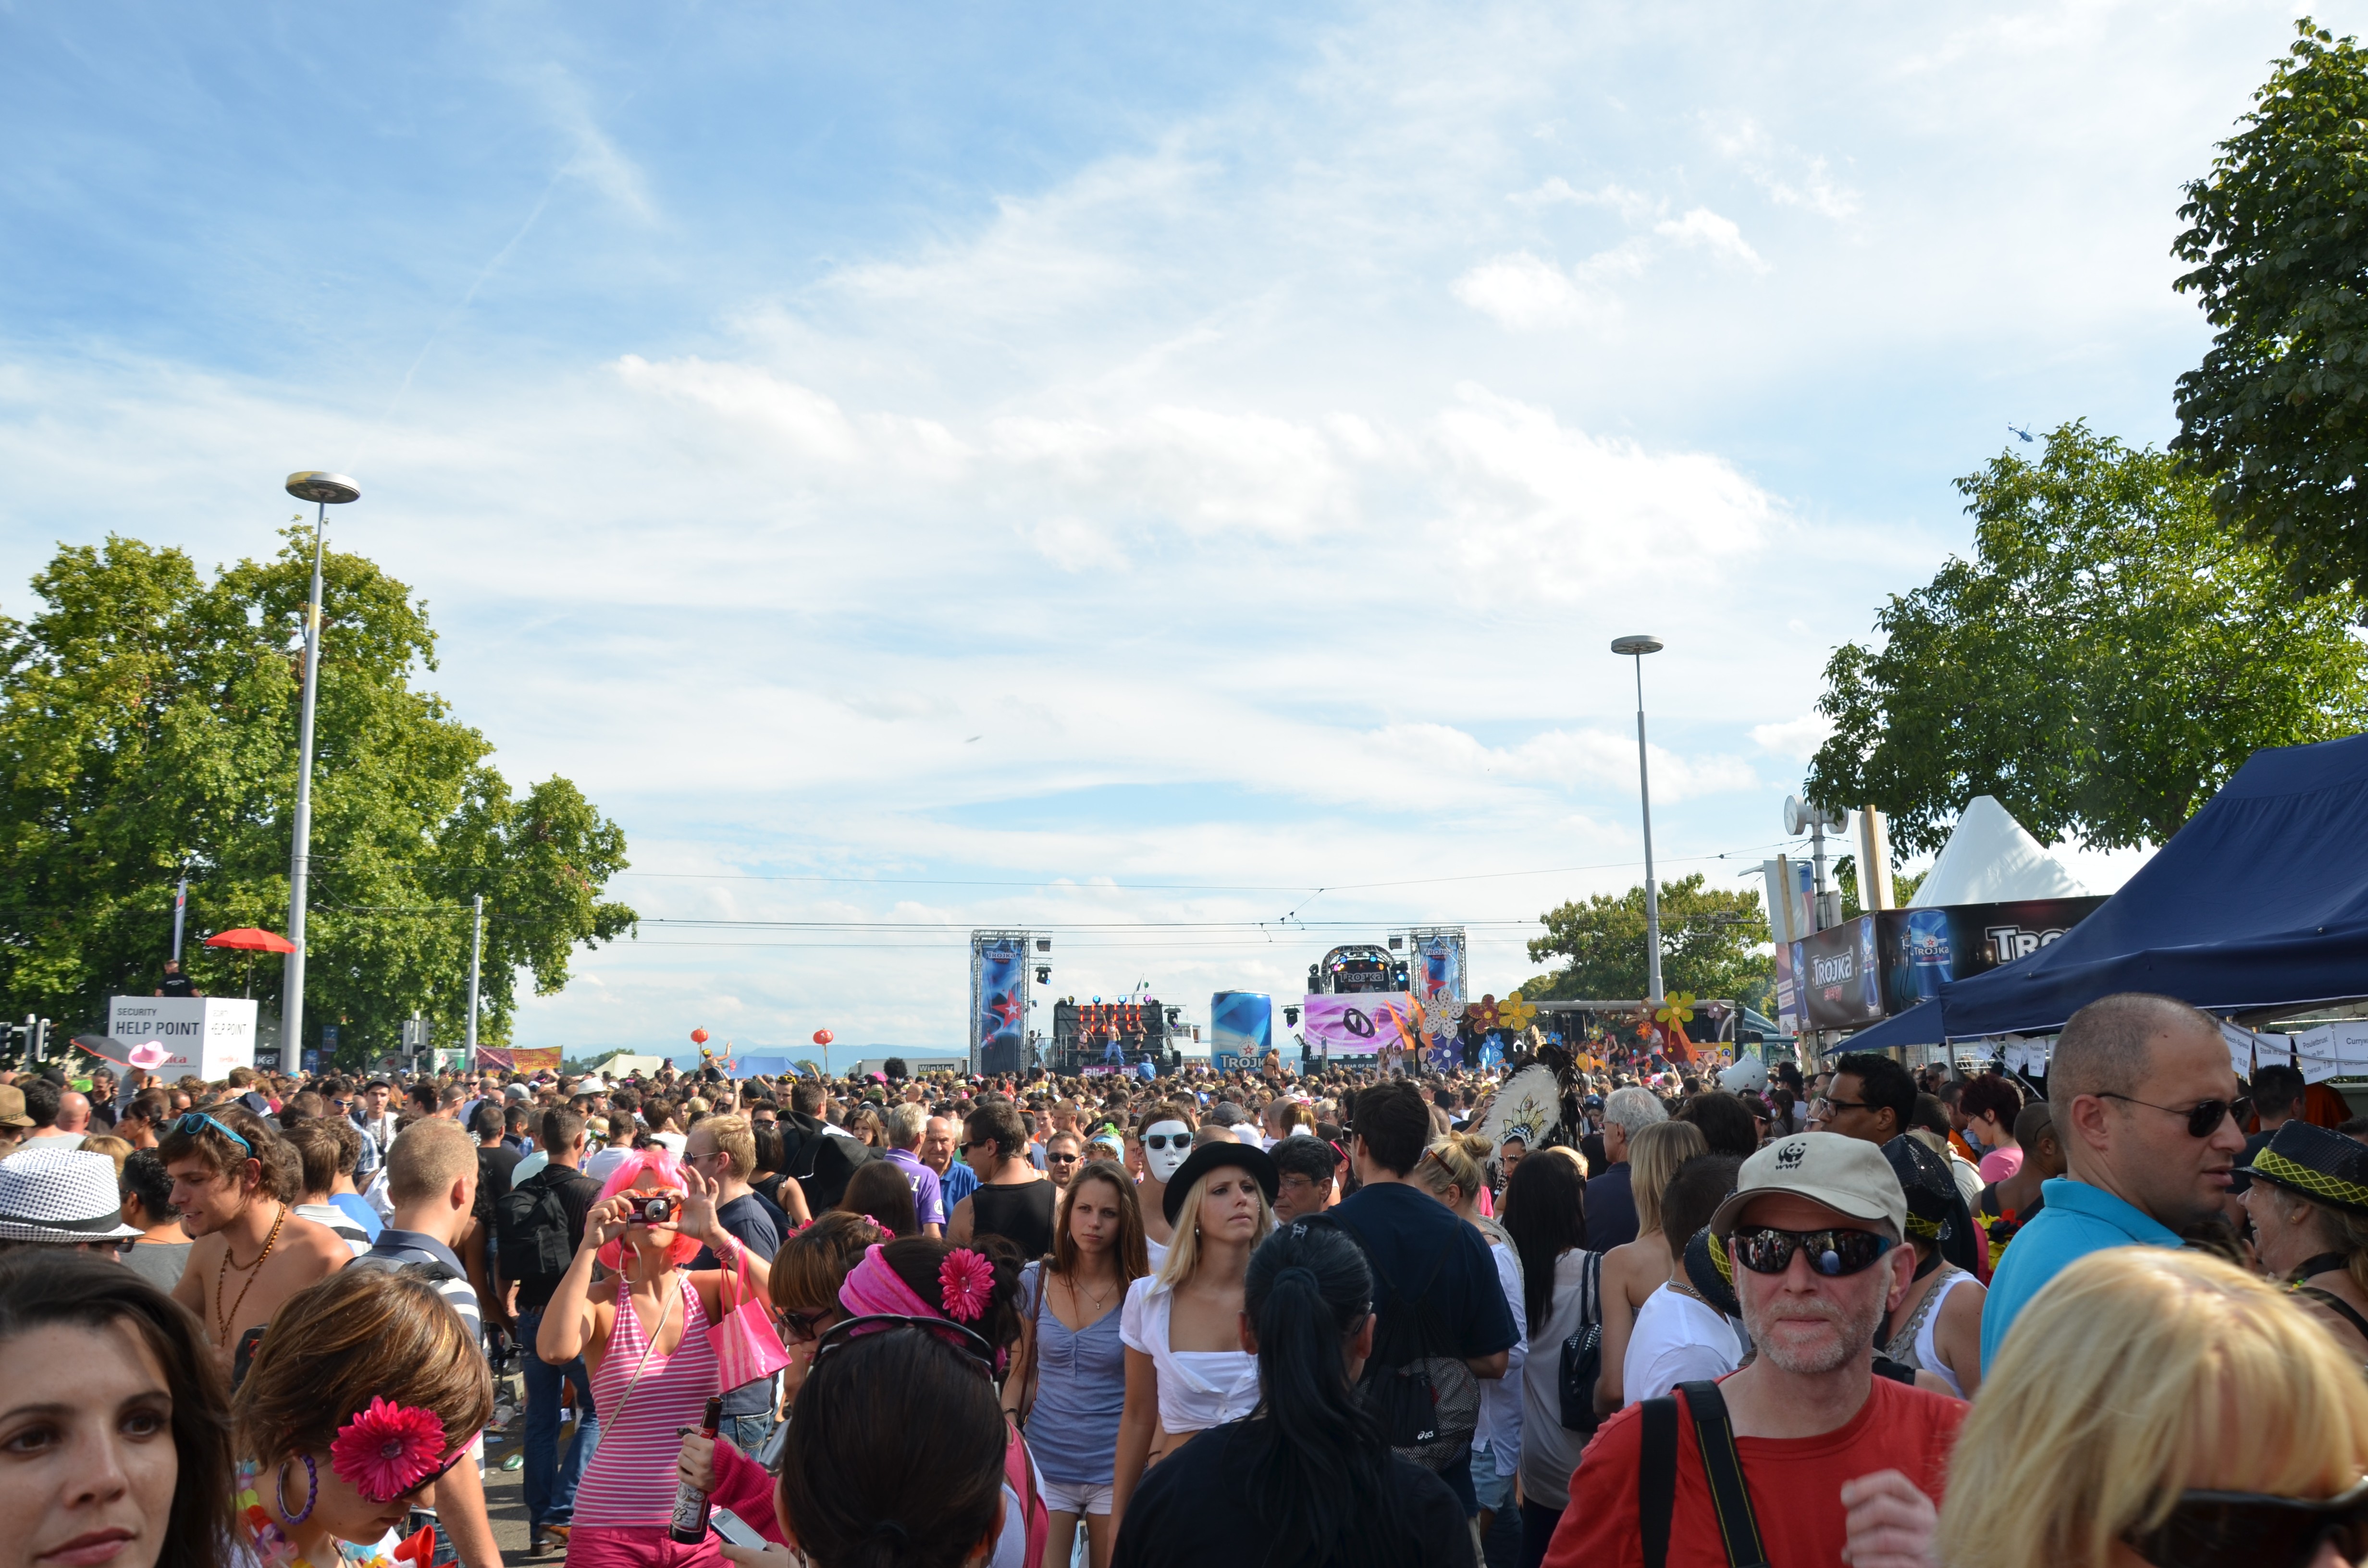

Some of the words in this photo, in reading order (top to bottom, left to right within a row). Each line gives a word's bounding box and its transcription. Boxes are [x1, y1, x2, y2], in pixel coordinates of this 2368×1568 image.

[117, 1008, 157, 1016] SECURITY
[116, 1021, 151, 1034] HELP
[156, 1022, 200, 1035] POINT
[2303, 1036, 2328, 1049] Pouletbrust
[517, 1058, 557, 1067] Spiesse
[1220, 1054, 1264, 1068] TROJK
[2237, 1057, 2247, 1068] 10.00
